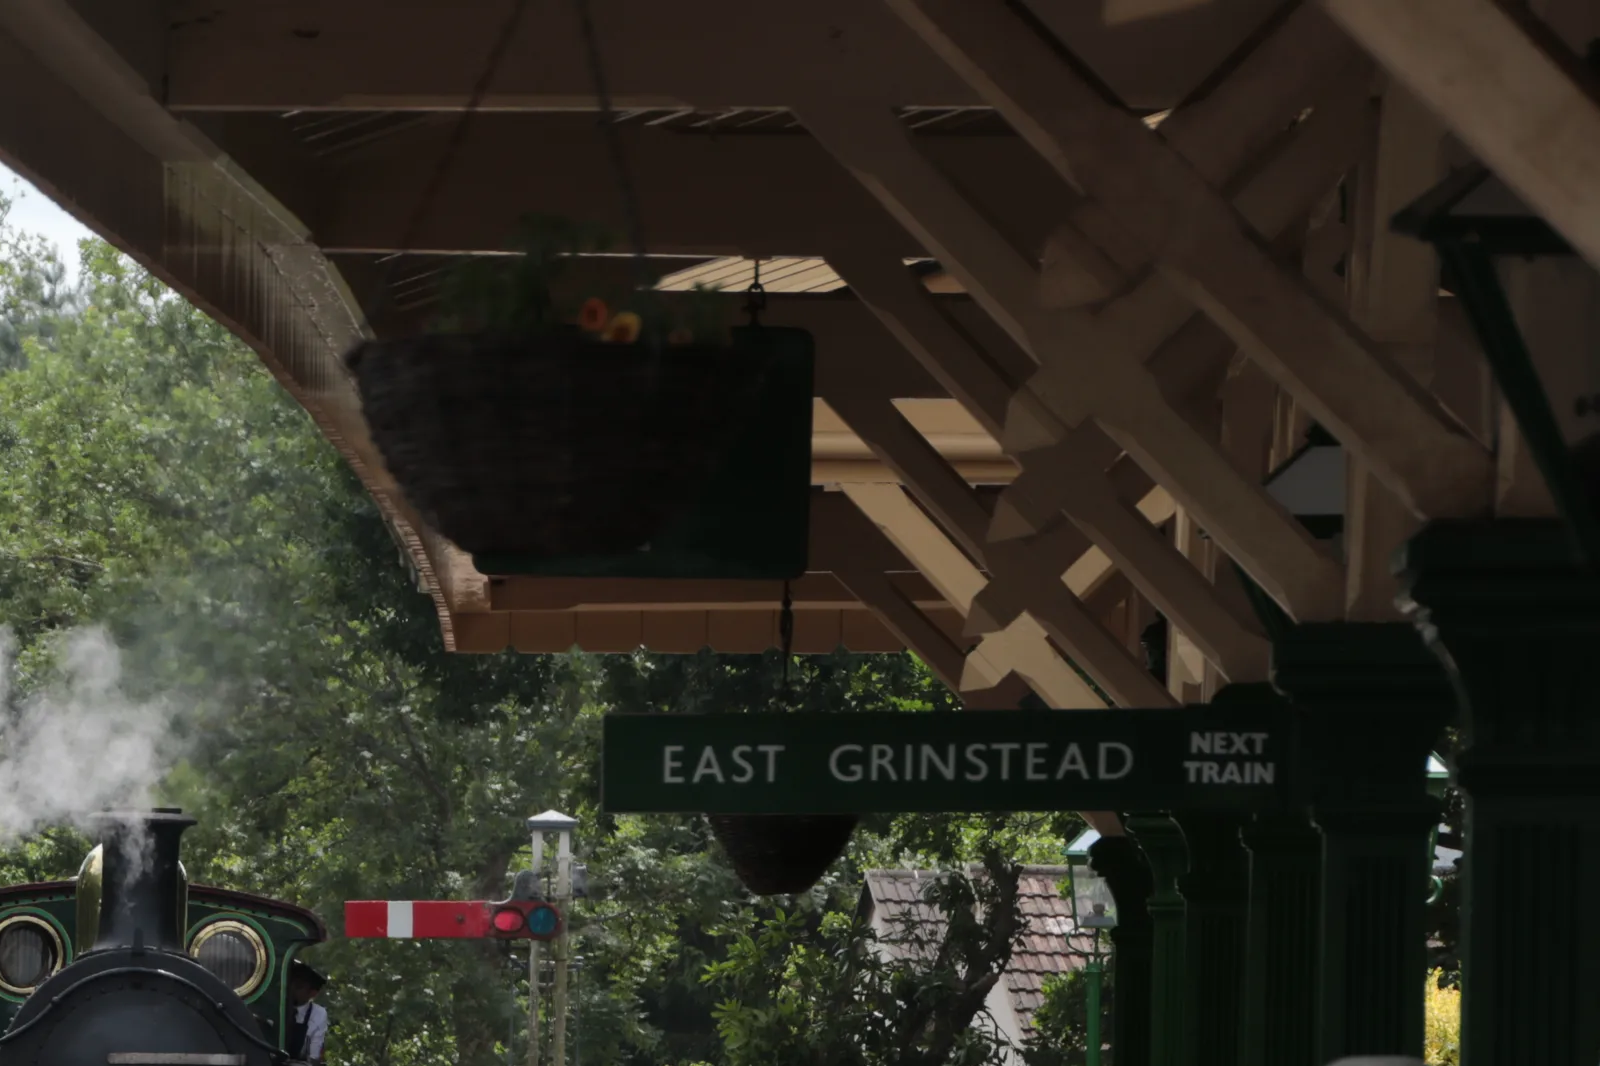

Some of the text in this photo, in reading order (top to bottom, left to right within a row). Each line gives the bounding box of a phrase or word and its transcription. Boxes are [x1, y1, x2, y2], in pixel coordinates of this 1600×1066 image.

[1190, 732, 1268, 754] NEXT
[662, 742, 1135, 783] EAST GRINSTEAD
[1184, 761, 1275, 784] TRAIN
